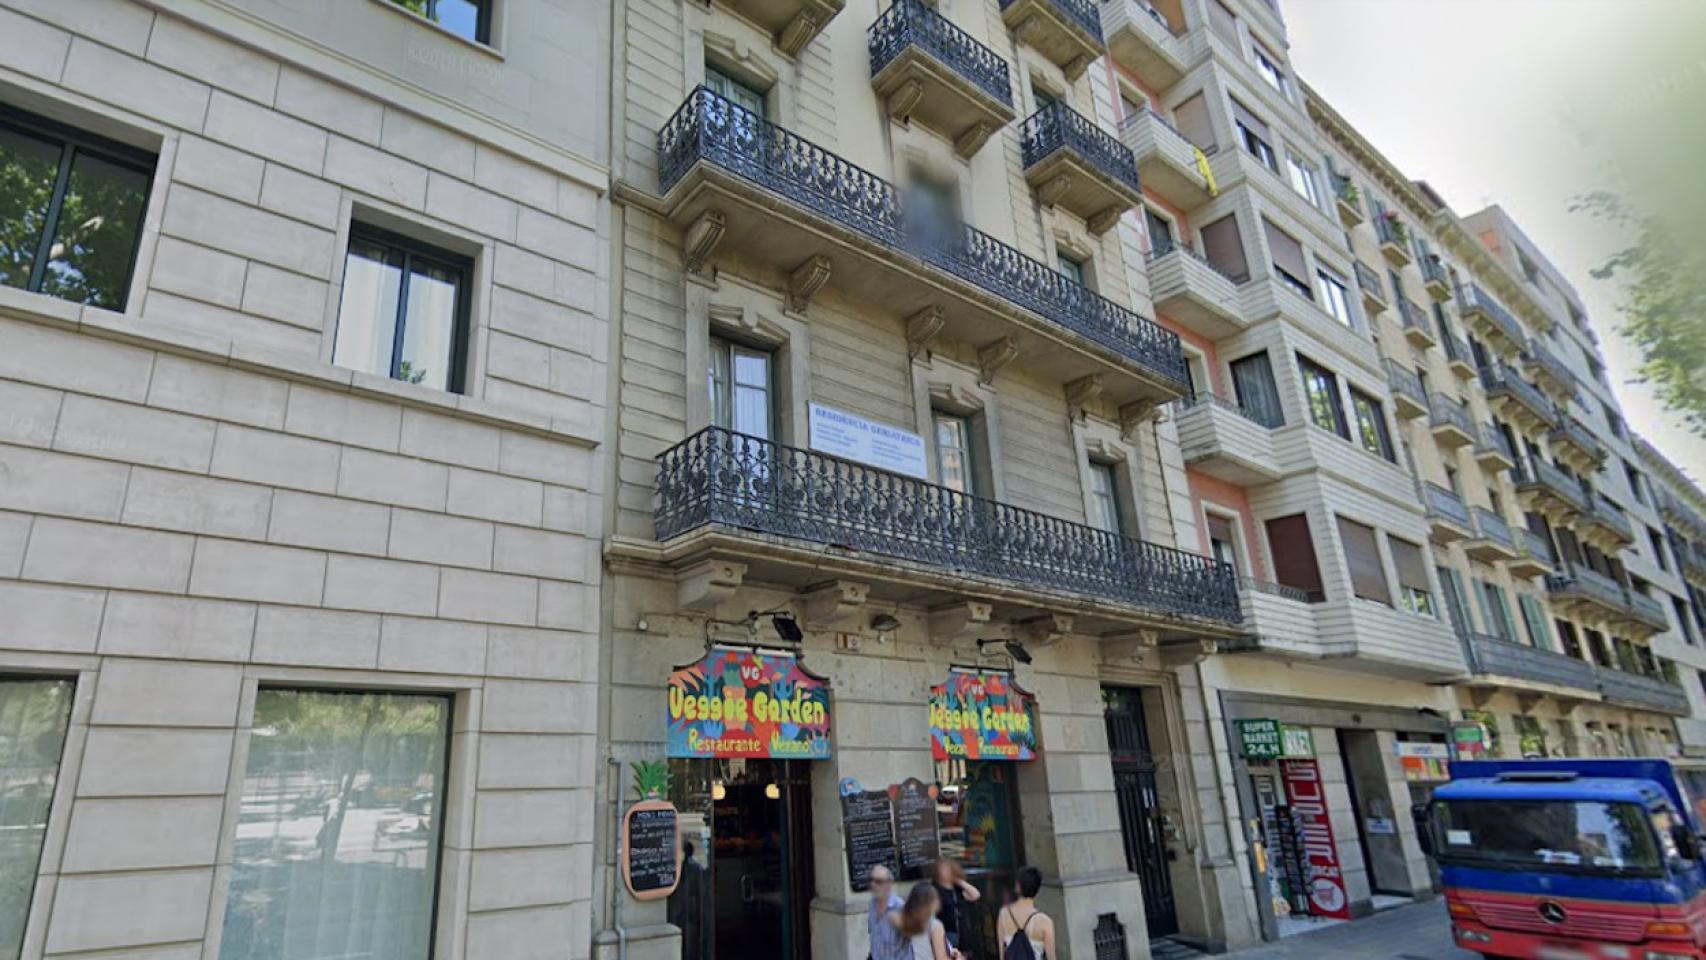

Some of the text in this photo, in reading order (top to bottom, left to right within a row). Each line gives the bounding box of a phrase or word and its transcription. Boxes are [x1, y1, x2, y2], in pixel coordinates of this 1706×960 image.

[741, 666, 760, 680] VG
[669, 686, 825, 724] Veggie Garden
[983, 704, 1030, 733] Garden
[1243, 721, 1275, 733] SUPER
[688, 728, 761, 752] Restaurante
[1242, 732, 1279, 743] MARKET
